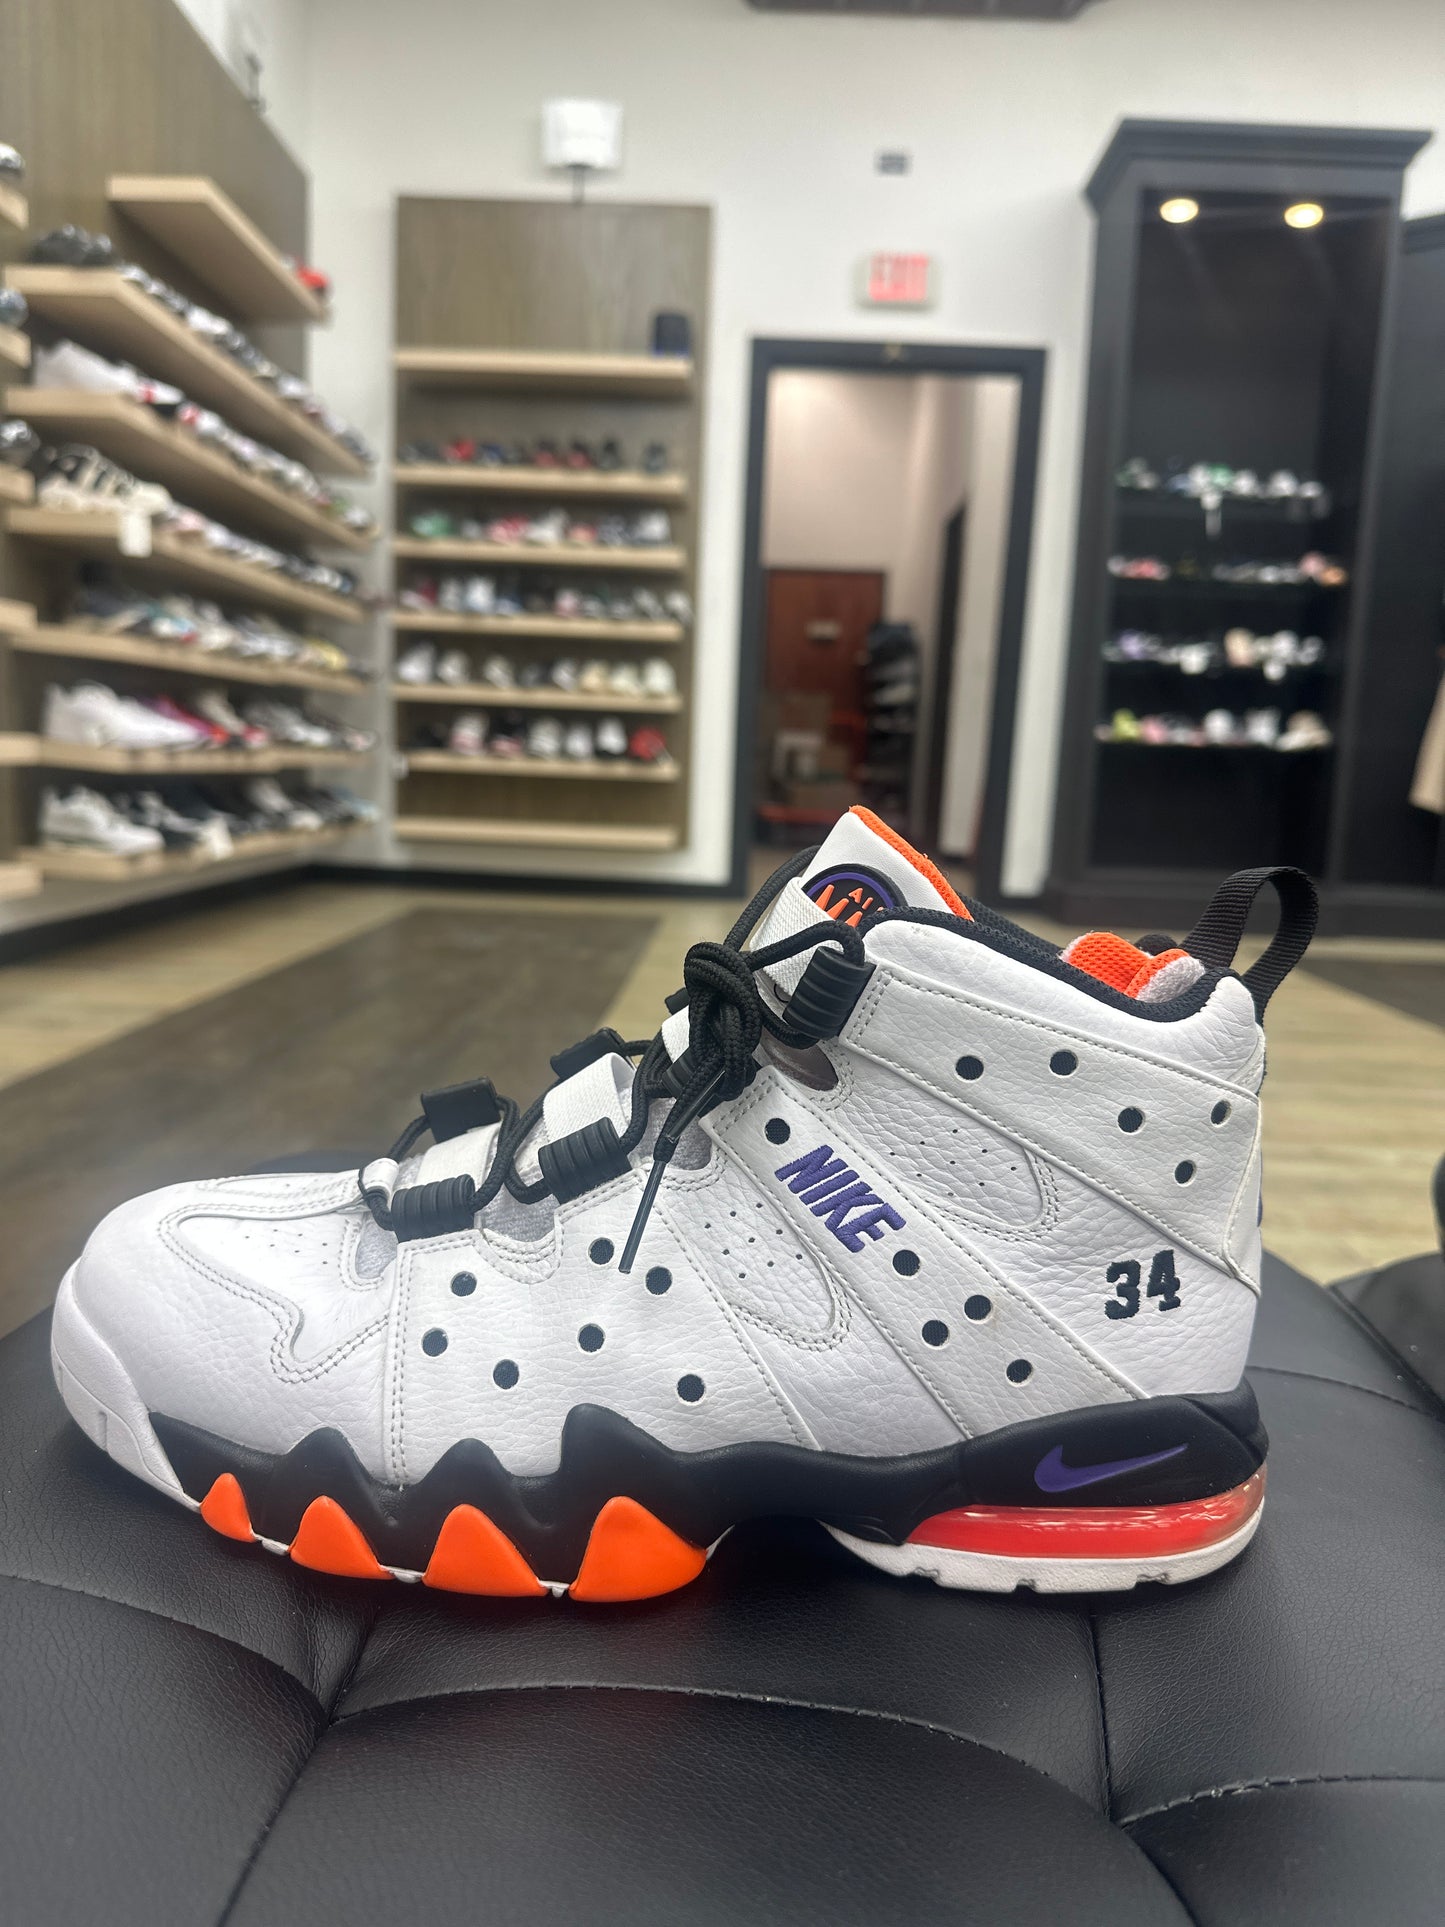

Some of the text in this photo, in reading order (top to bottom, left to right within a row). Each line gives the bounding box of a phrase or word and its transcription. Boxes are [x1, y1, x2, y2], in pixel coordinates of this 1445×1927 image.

[848, 887, 884, 911] AI
[774, 1144, 906, 1253] NIKE
[1104, 1249, 1181, 1320] 34
